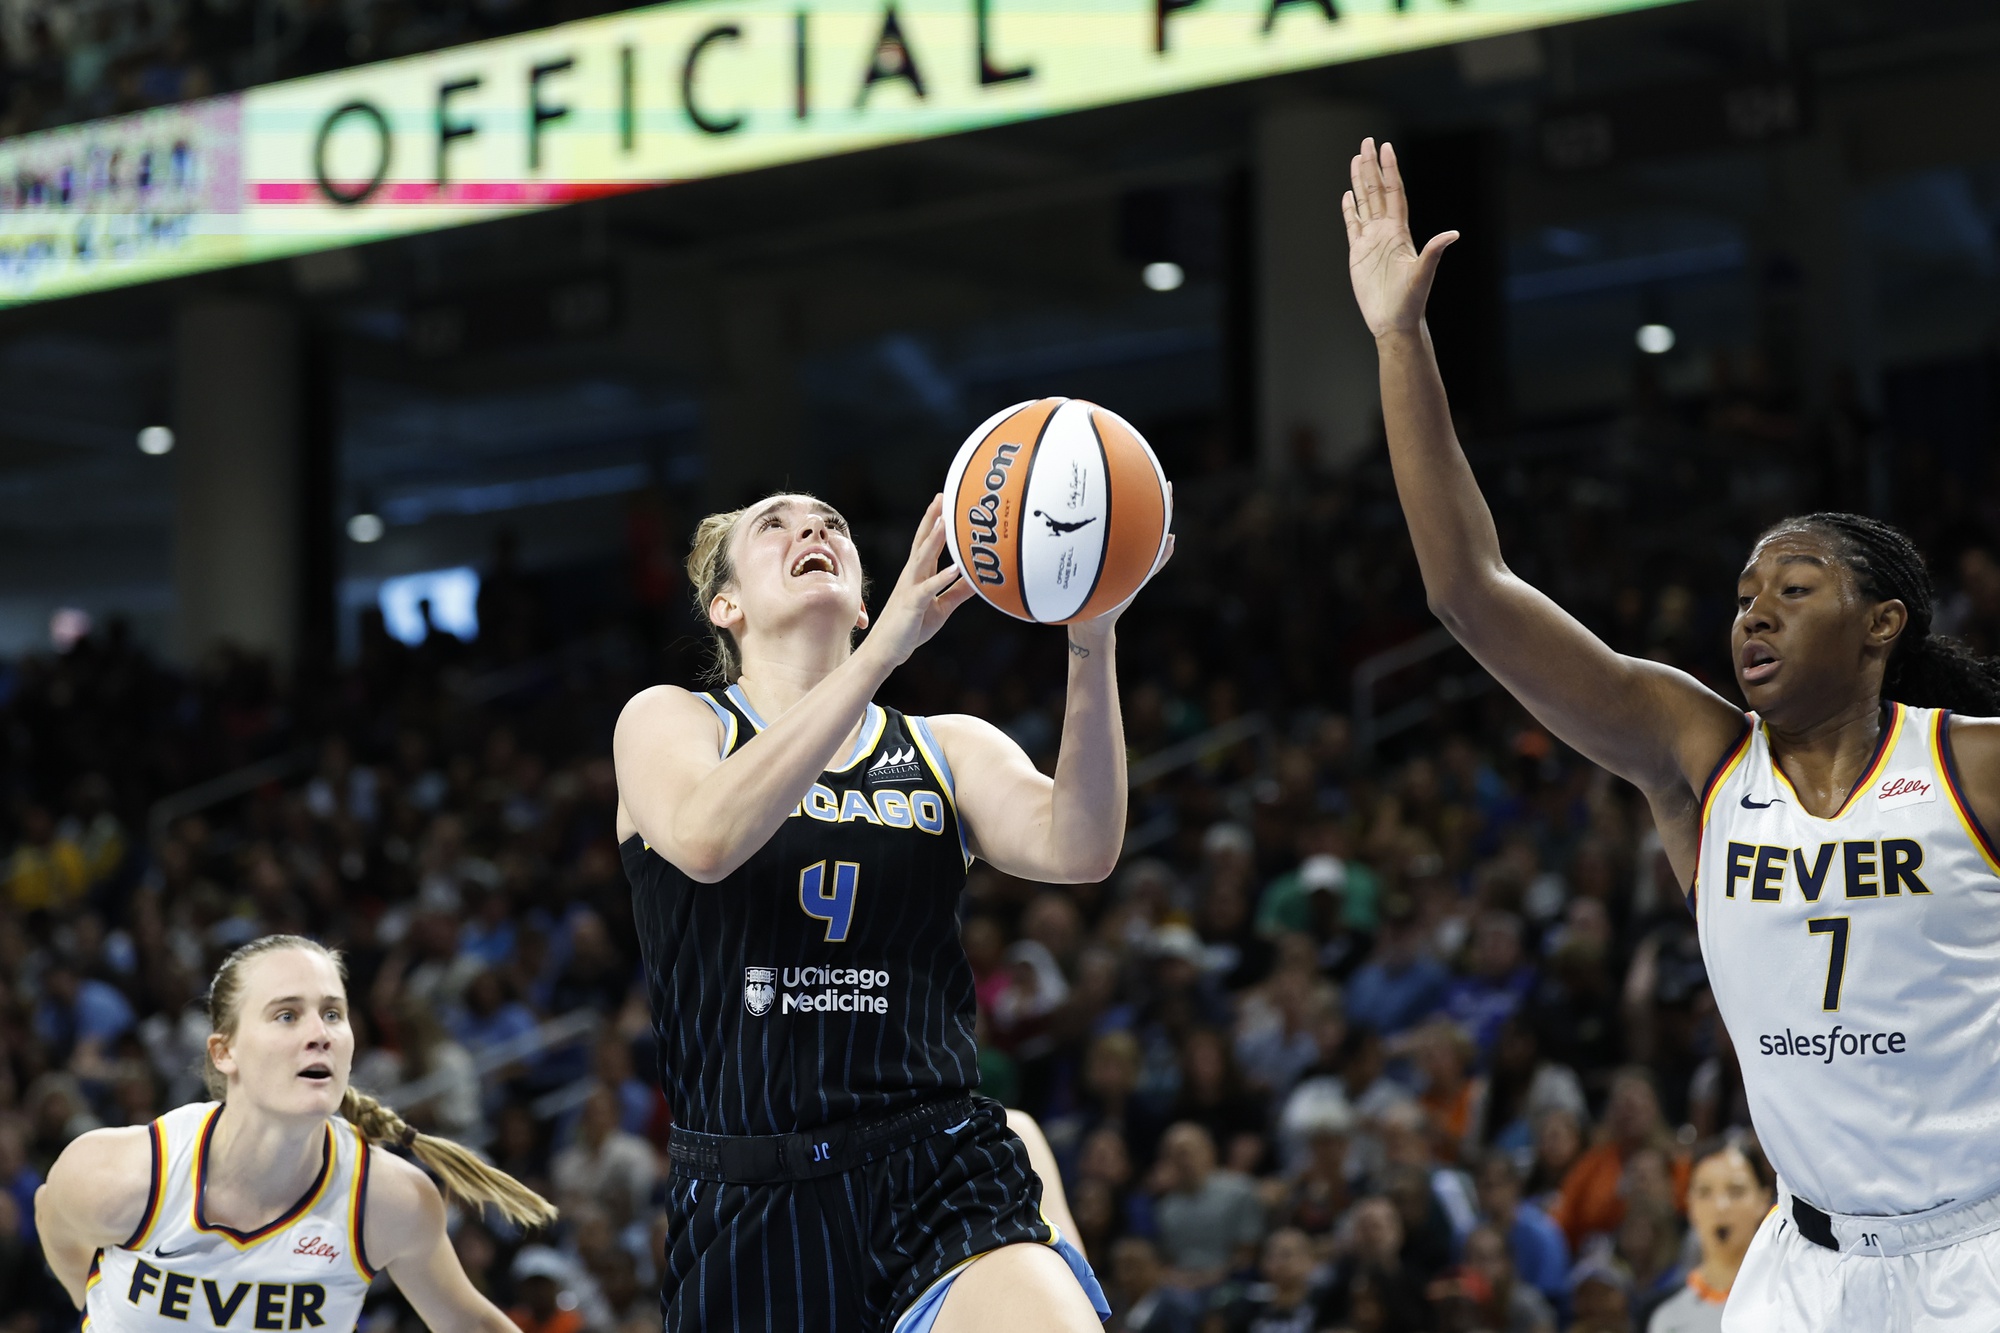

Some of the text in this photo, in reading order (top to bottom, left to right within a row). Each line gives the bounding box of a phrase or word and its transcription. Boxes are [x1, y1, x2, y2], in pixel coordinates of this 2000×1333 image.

[314, 0, 1034, 206] OFFICIAL
[968, 441, 1022, 587] Wilson
[1056, 552, 1067, 585] OFFICIAL
[1063, 546, 1075, 590] GAME BALL
[868, 764, 921, 778] MAGELLAN
[1878, 778, 1931, 800] Lilly
[1725, 837, 1934, 903] FEVER
[799, 859, 860, 942] 4
[782, 964, 890, 989] UChicago
[1806, 916, 1851, 1012] 7
[782, 989, 889, 1015] Medicine
[1759, 1025, 1906, 1064] salesforce
[293, 1236, 341, 1264] Lilly
[127, 1258, 327, 1331] FEVER
